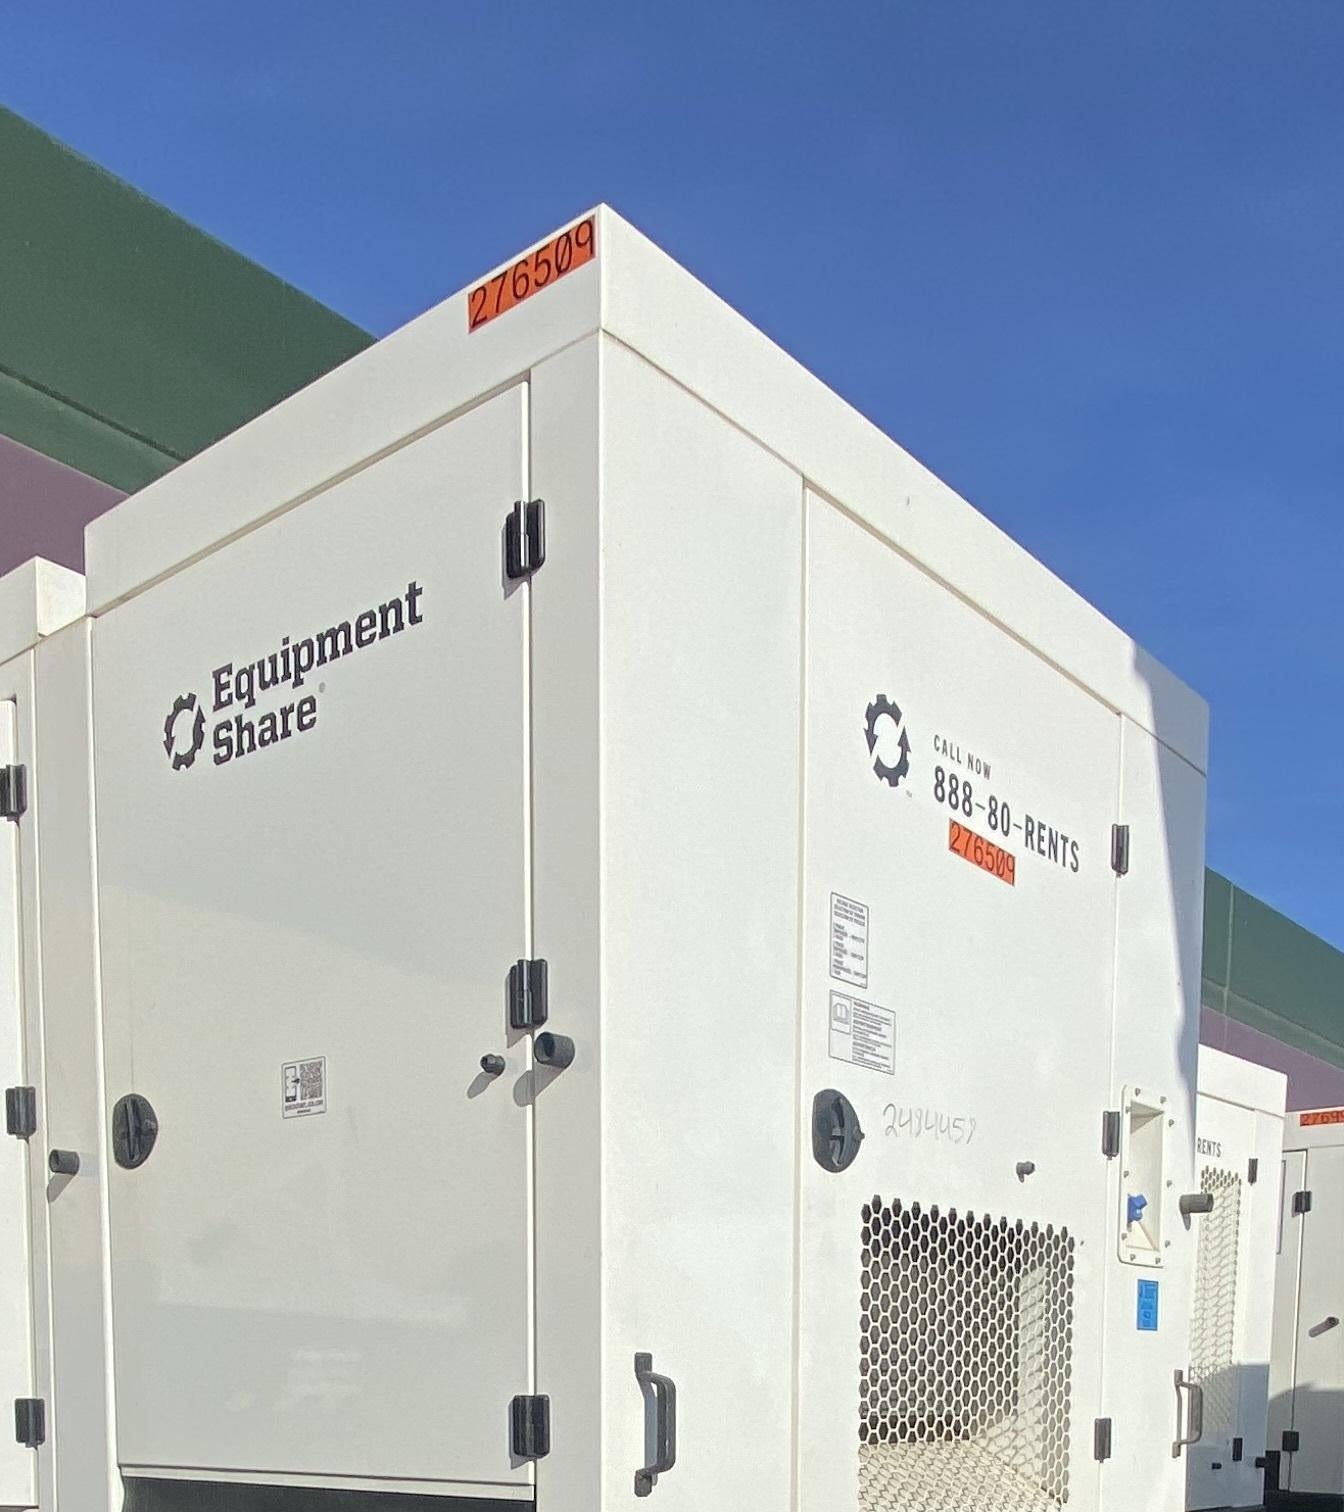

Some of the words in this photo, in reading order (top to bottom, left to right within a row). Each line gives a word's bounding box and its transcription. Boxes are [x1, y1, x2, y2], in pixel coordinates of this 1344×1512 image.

[471, 218, 594, 329] 276509
[212, 580, 423, 713] Equipment
[212, 694, 317, 766] Share
[933, 733, 962, 765] CALL
[967, 752, 992, 781] NOW
[933, 764, 1080, 874] 888-80-RENTS
[950, 820, 1016, 886] 276509
